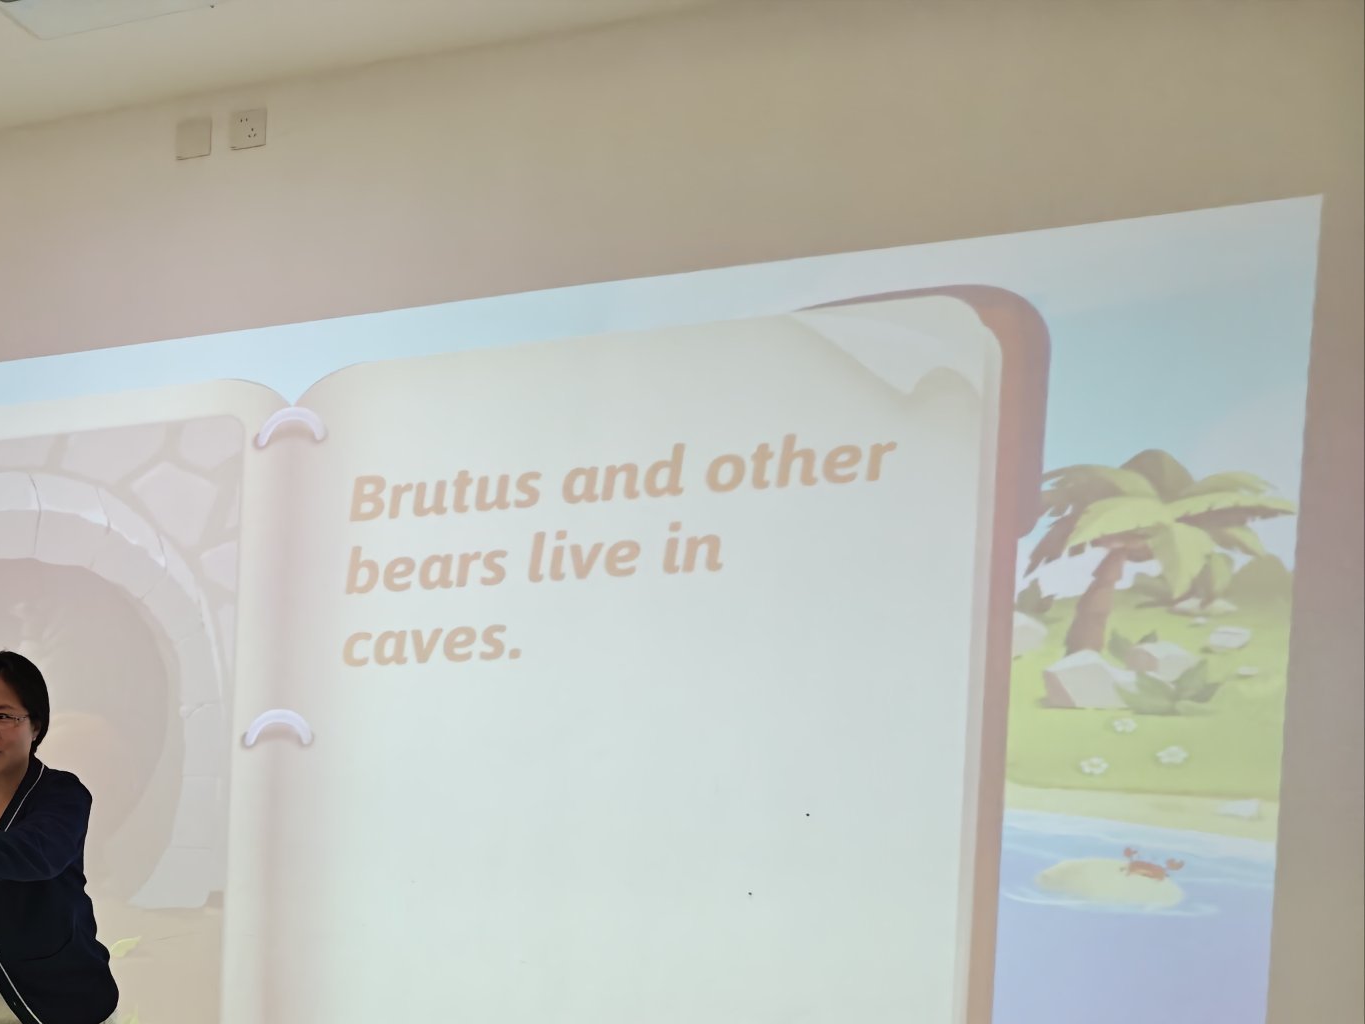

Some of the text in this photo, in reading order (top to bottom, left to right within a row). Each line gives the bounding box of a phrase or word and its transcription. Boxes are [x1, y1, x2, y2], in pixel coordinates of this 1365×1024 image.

[349, 433, 898, 523] Brutus and other
[345, 521, 724, 595] bears live in
[341, 623, 522, 668] caves.
